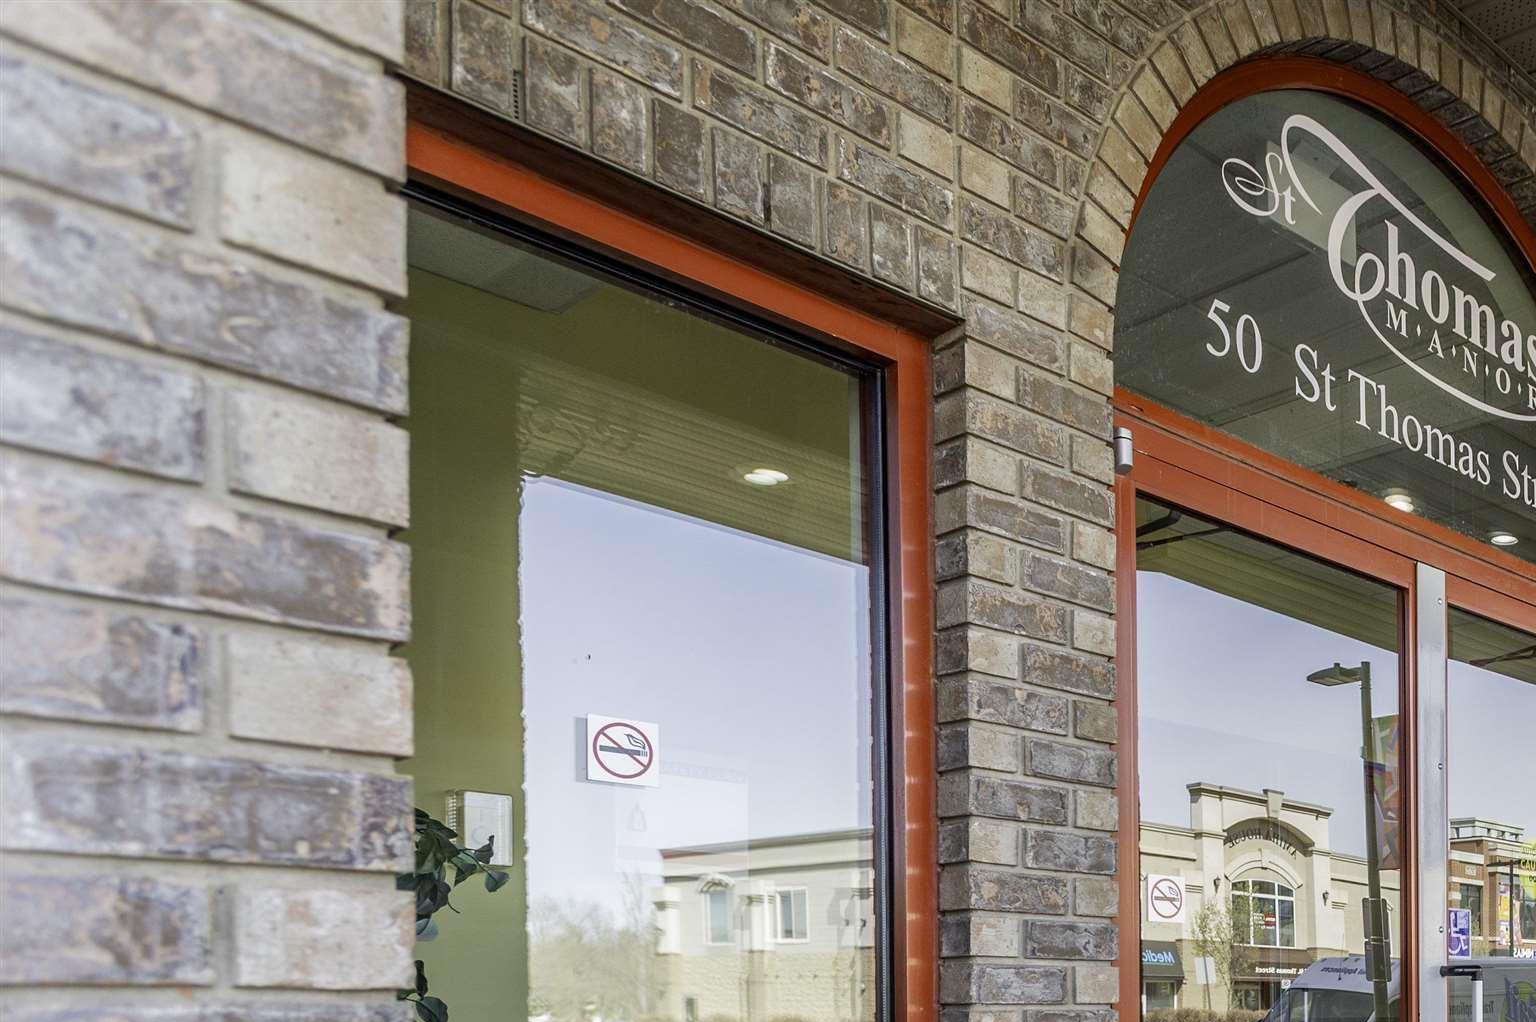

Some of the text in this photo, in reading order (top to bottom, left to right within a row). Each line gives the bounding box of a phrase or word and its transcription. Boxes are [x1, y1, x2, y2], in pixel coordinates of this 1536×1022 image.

[1206, 298, 1263, 375] 50
[1294, 343, 1337, 413] St
[1347, 368, 1491, 486] Thomas
